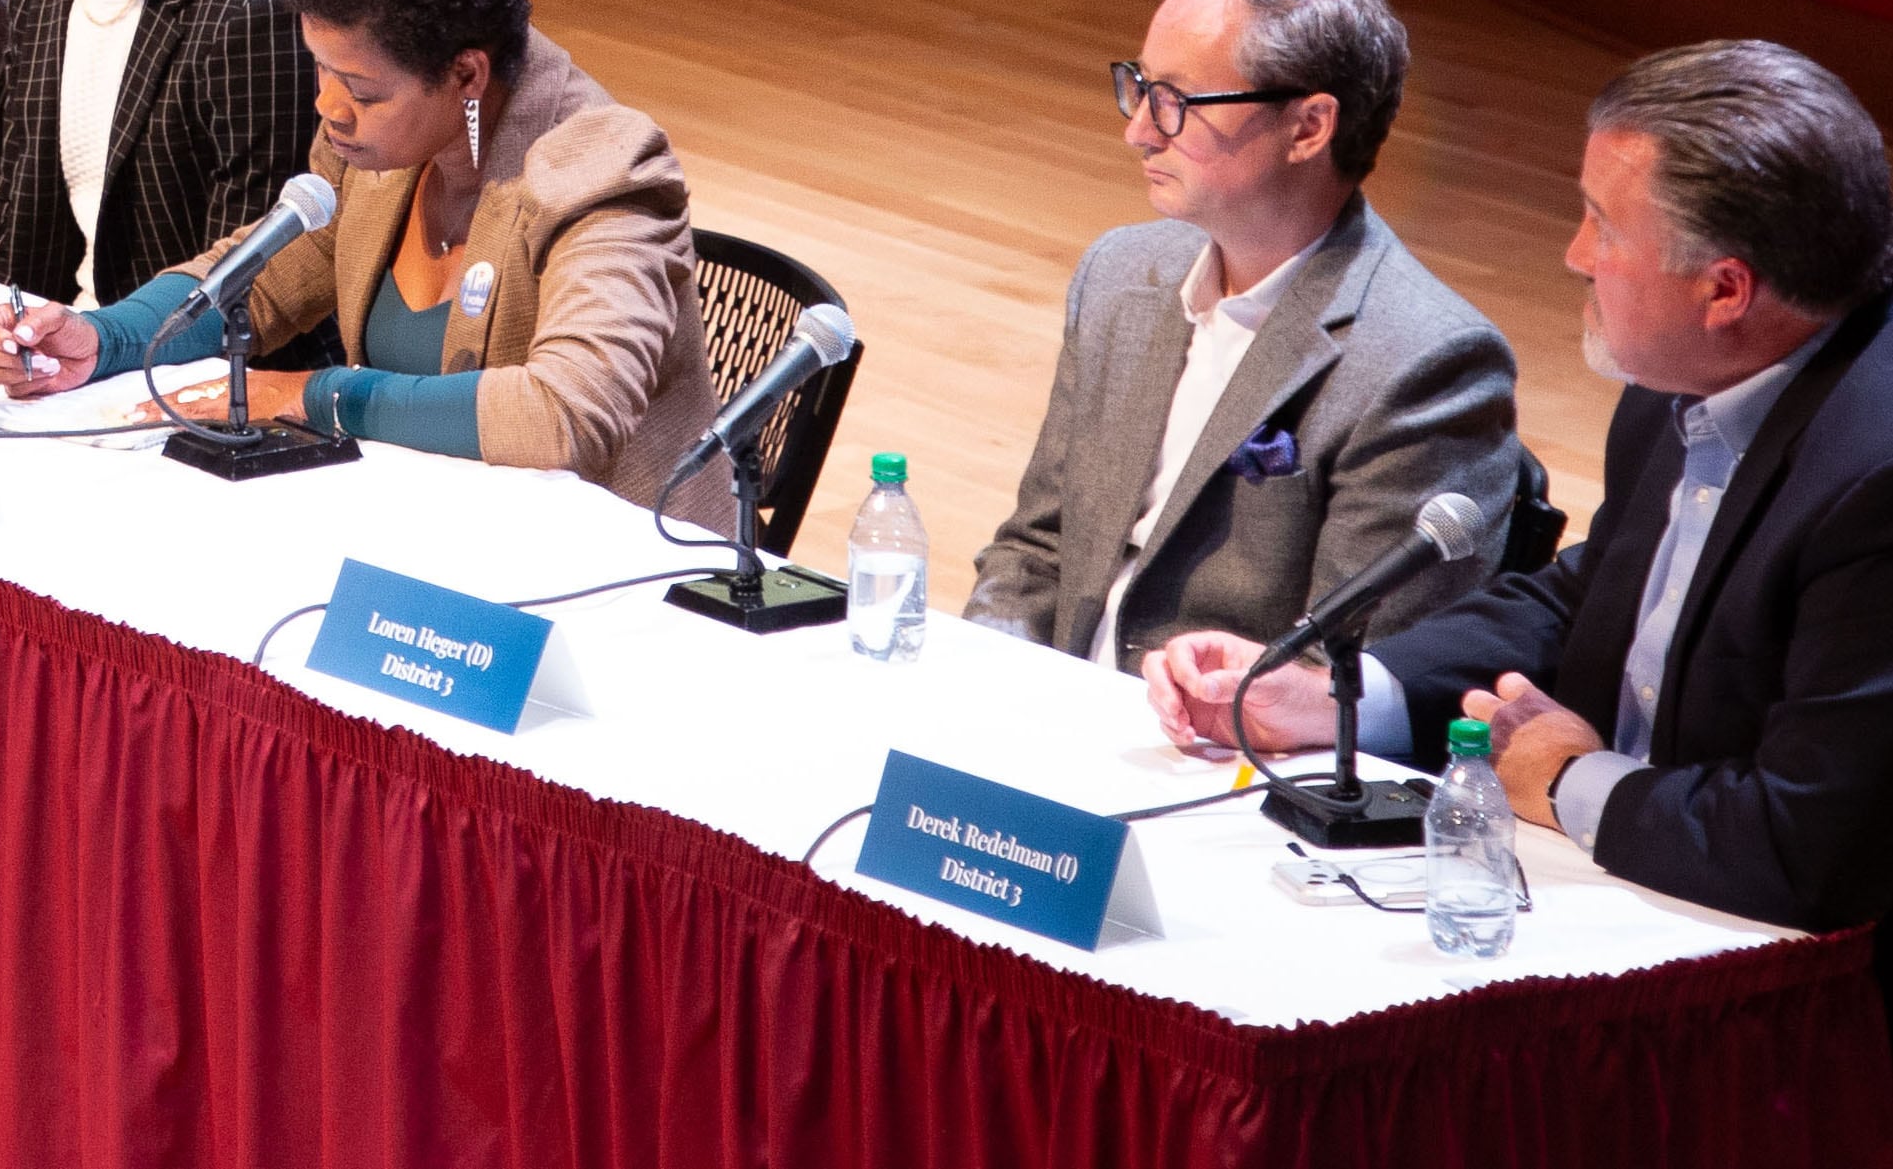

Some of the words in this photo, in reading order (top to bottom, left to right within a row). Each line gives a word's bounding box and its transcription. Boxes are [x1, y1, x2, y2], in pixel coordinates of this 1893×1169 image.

[367, 611, 417, 646] Loren
[416, 626, 469, 661] Heger
[466, 641, 494, 672] (D)
[380, 652, 444, 692] District
[441, 677, 455, 697] 3
[907, 804, 963, 844] Derek
[963, 823, 1054, 874] Redelman
[1055, 853, 1078, 885] (I)
[941, 857, 1010, 900] District
[1009, 887, 1023, 907] 3
